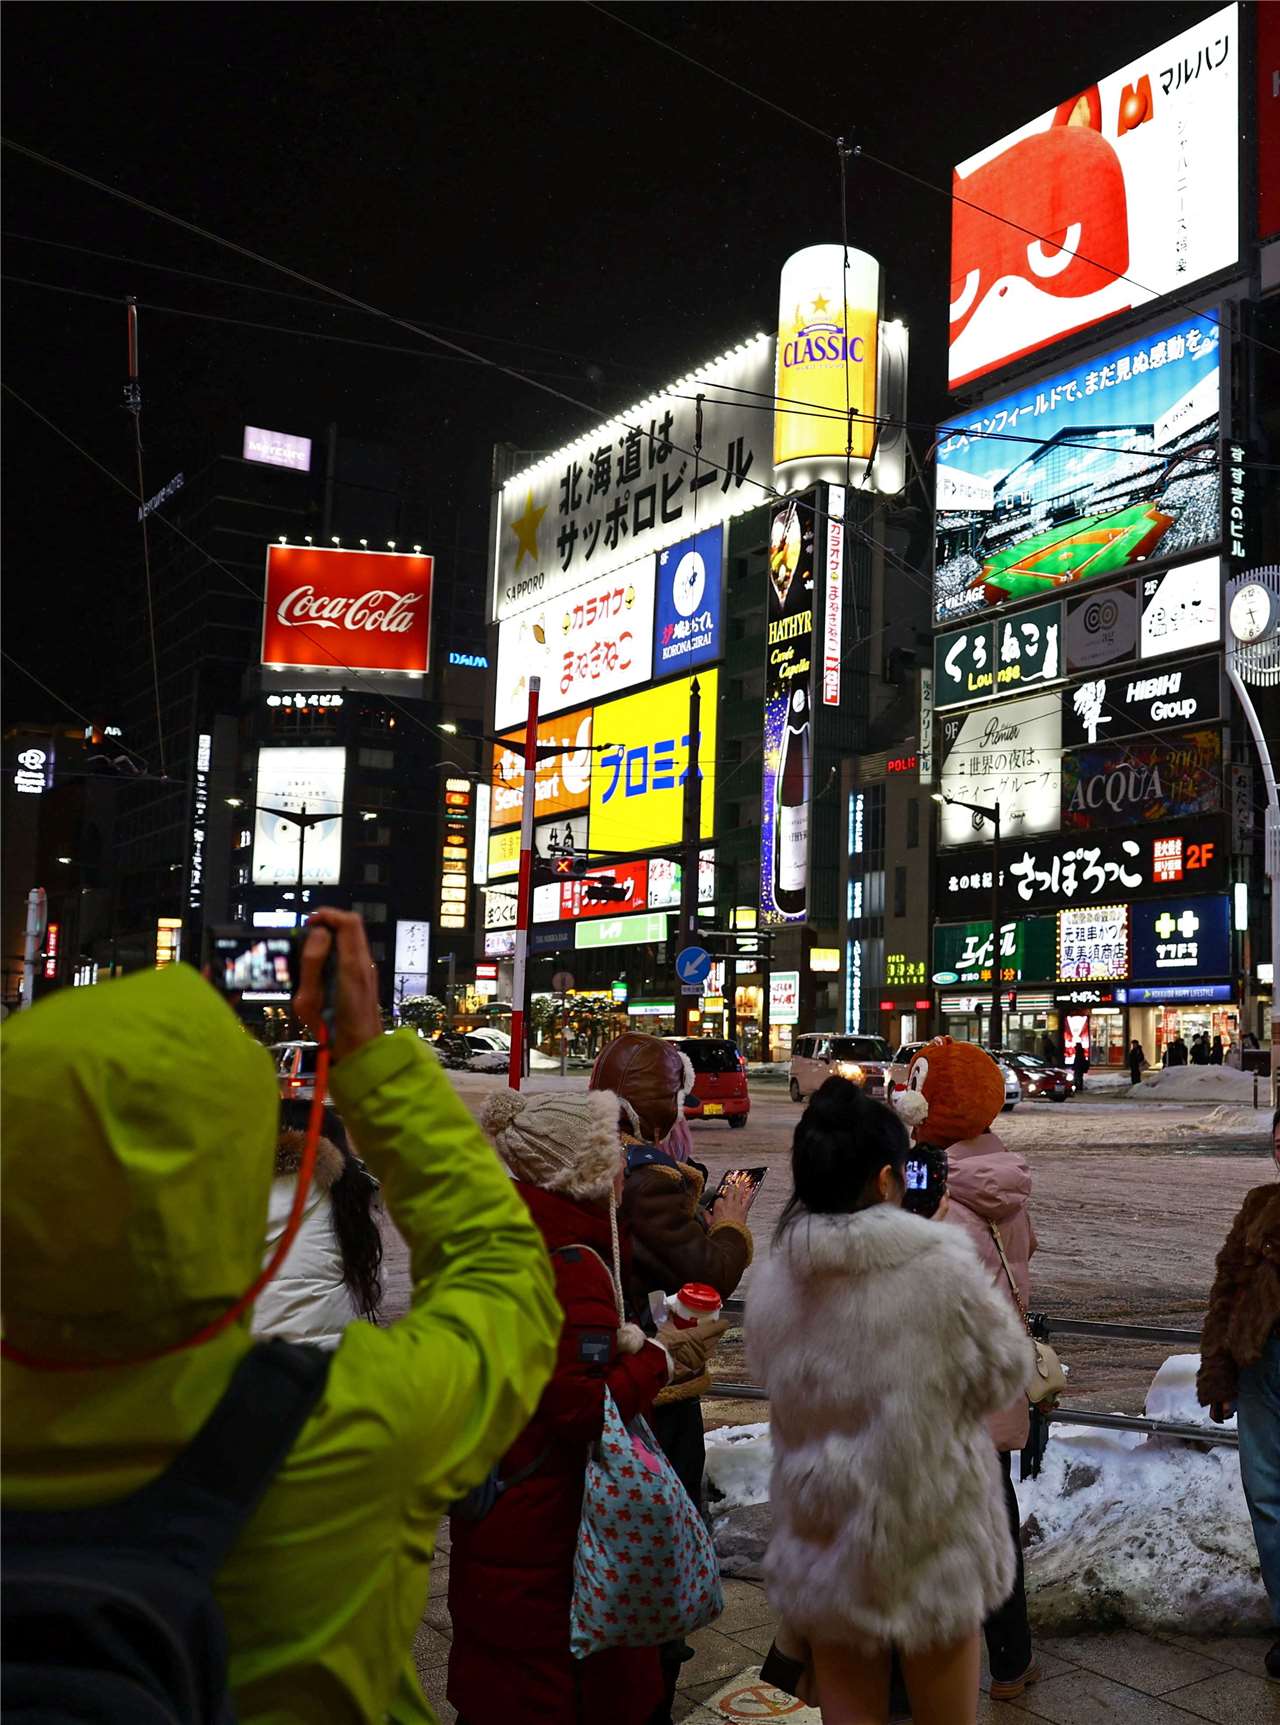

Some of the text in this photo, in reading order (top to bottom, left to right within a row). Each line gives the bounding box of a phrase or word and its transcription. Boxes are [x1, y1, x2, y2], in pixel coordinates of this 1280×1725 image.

[1159, 35, 1229, 95] マルハン
[784, 336, 864, 367] CLASSIC
[559, 410, 675, 515] 北海道は
[556, 437, 754, 571] サッポロビール
[1231, 447, 1246, 558] すすきのビル
[506, 573, 545, 604] SAPPORO
[277, 584, 423, 633] Coca-Cola
[572, 587, 625, 630] カラオケ
[768, 610, 812, 645] HATHYR
[560, 631, 633, 694] まねきねこ
[1126, 672, 1181, 704] HIBIKI
[1150, 698, 1197, 722] Group
[945, 722, 959, 741] 9F
[1068, 766, 1164, 812] ACQUA
[273, 867, 333, 878] DAKIN
[1010, 841, 1143, 900] さっぽろっこ
[1186, 843, 1215, 870] 2F
[1064, 943, 1124, 961] 恵美須商店
